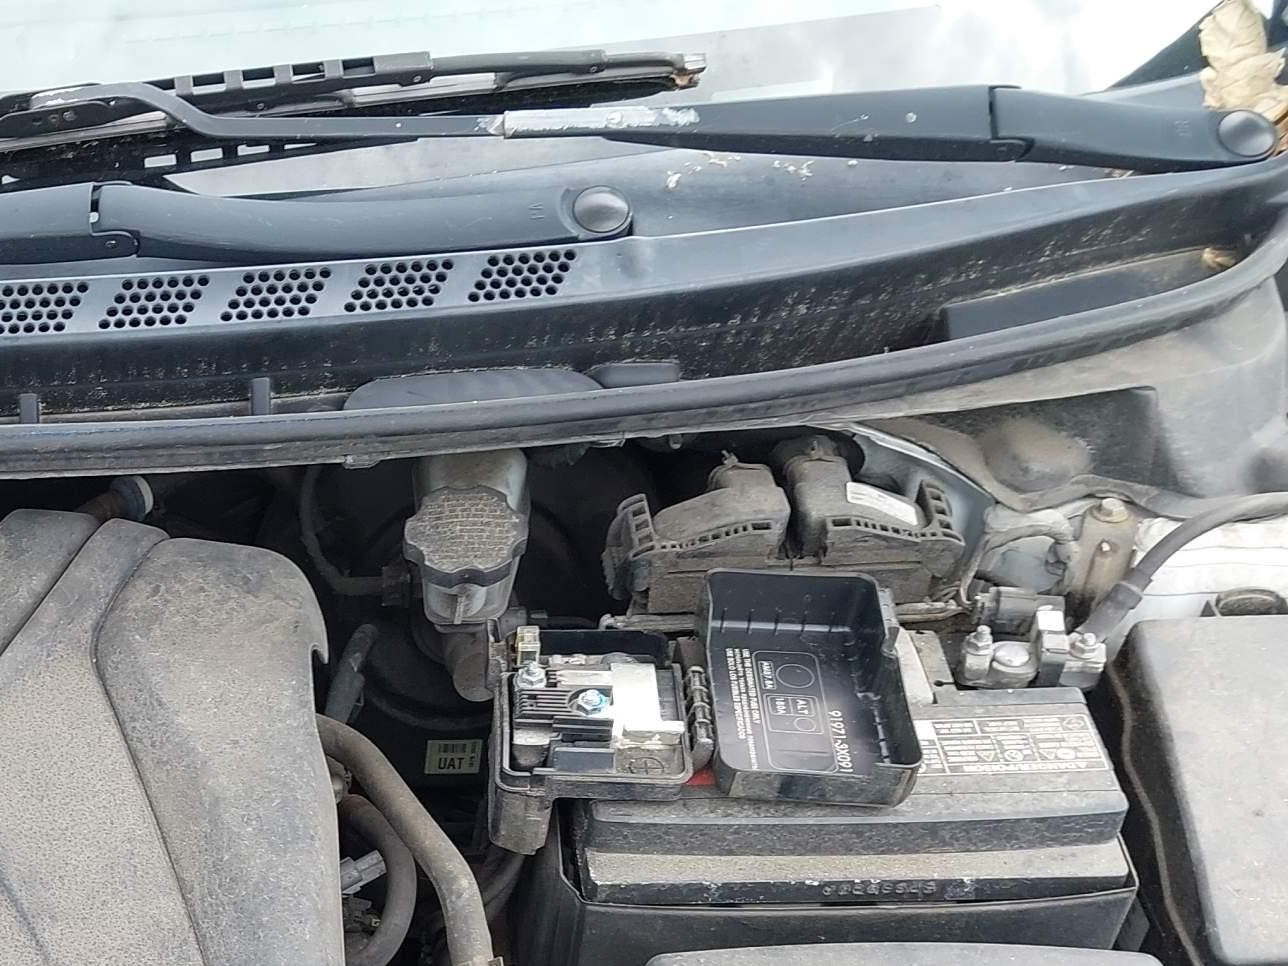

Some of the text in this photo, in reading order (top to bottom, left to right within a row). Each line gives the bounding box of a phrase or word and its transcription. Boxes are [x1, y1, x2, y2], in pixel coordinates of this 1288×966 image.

[796, 699, 808, 714] ALT
[827, 710, 854, 773] 91971-3X091
[438, 757, 465, 770] UAT
